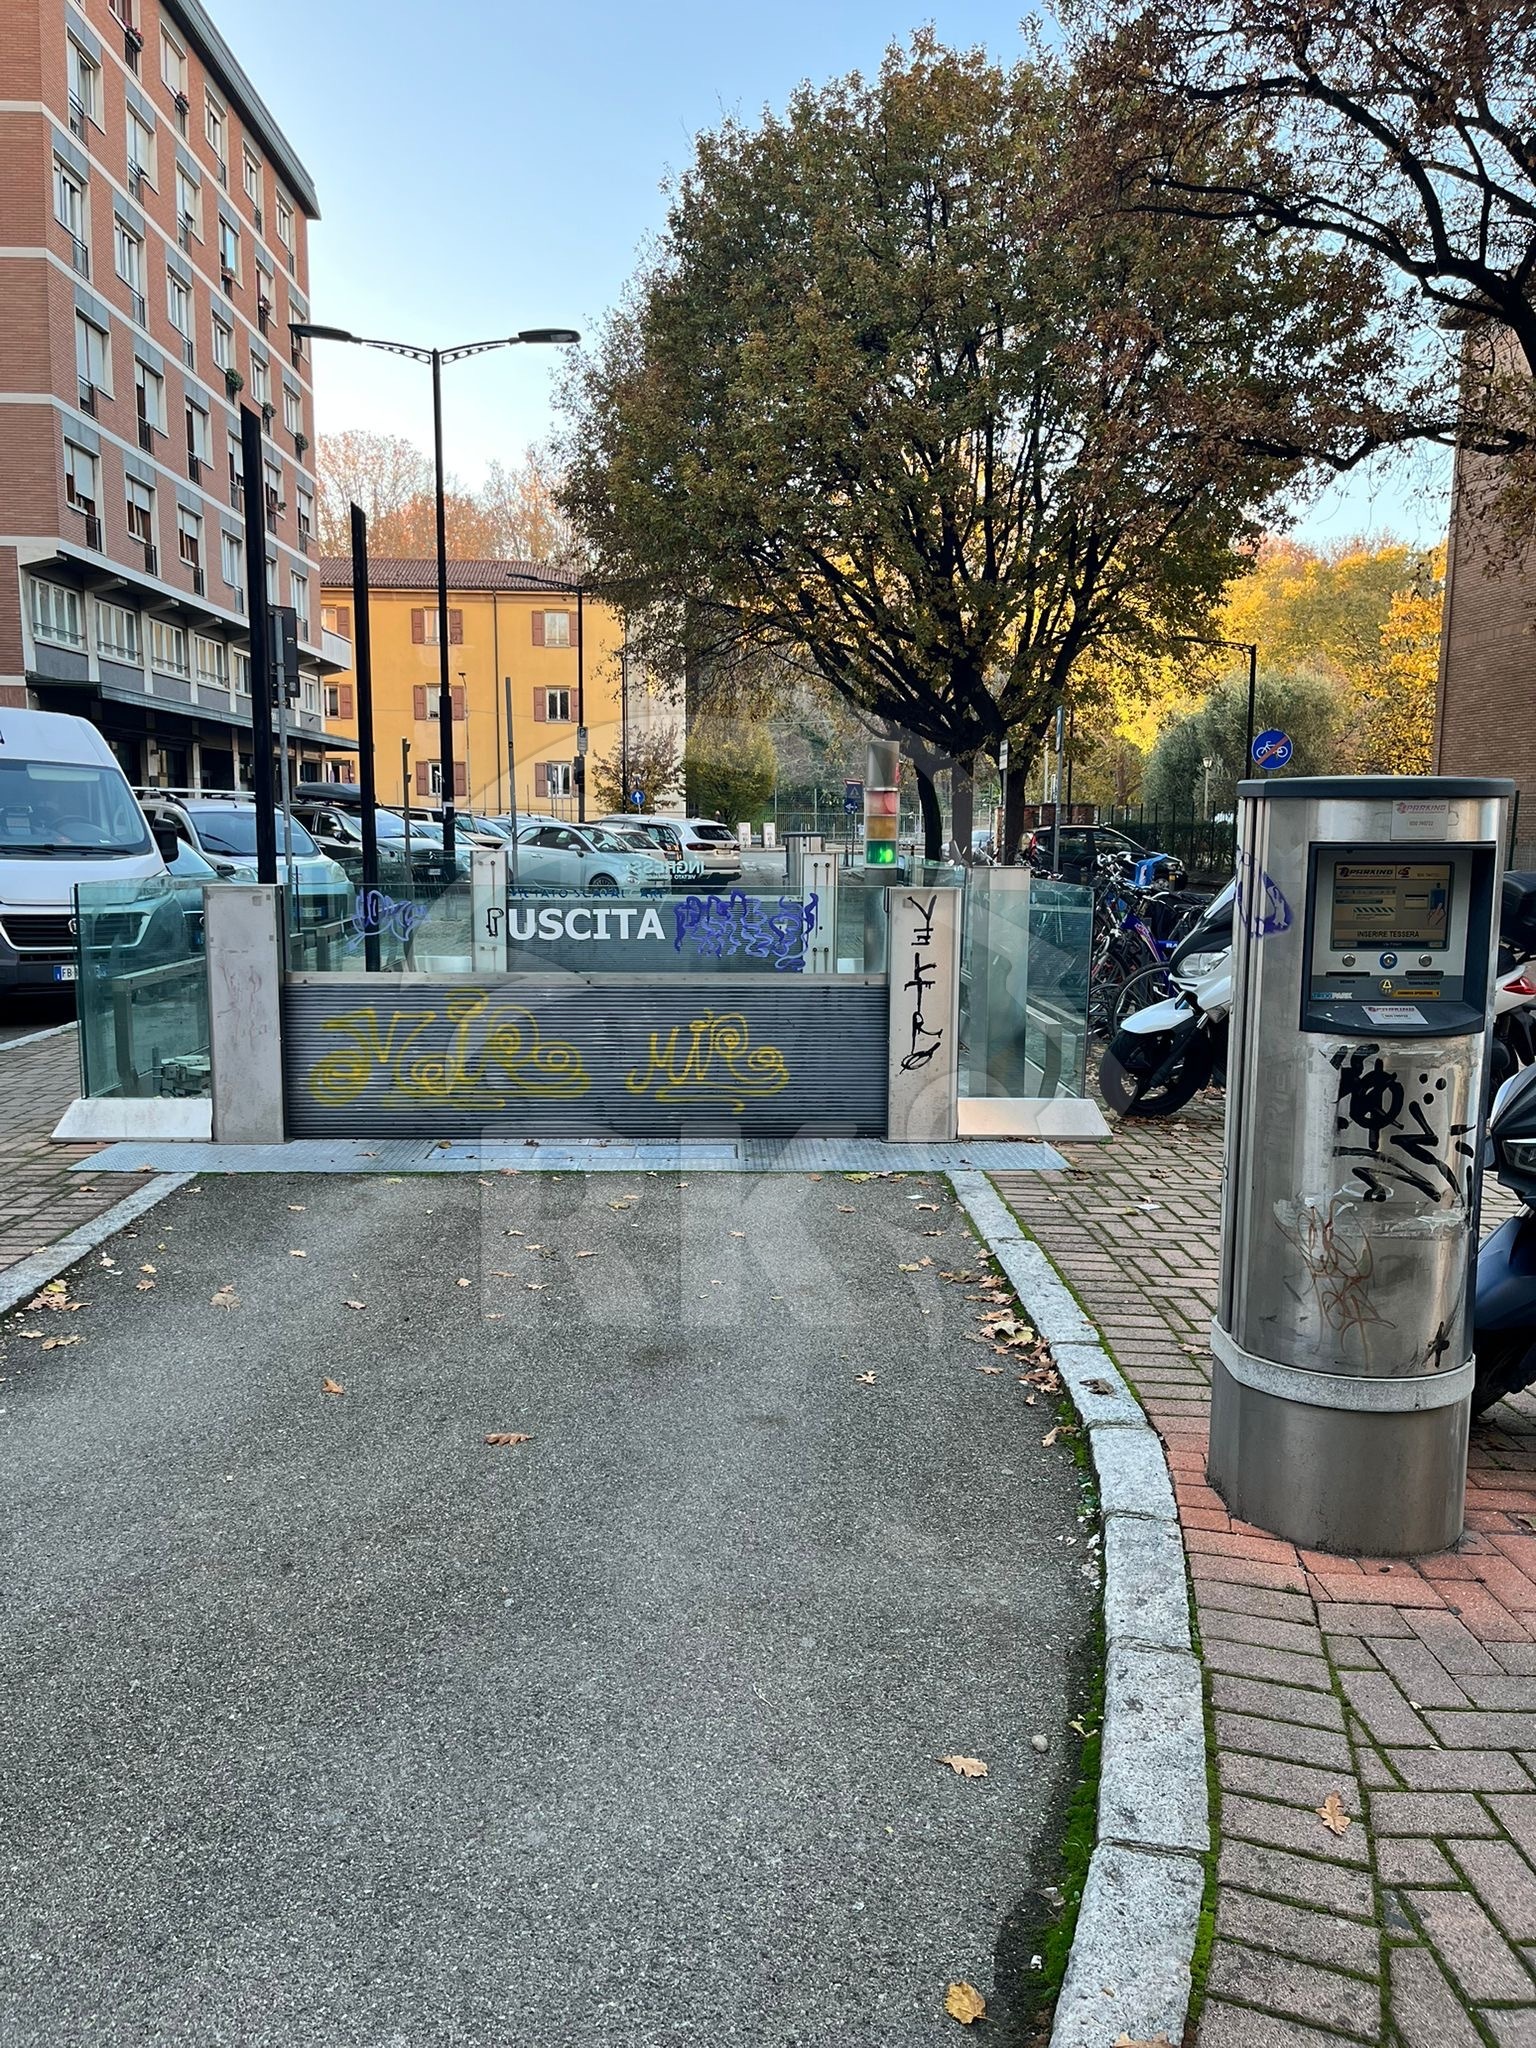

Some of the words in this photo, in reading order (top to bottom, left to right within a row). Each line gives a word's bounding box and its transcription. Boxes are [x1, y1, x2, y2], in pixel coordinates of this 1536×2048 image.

[508, 908, 665, 940] USCITA
[1357, 930, 1388, 938] INSERIRE
[1389, 930, 1420, 938] TESSERA
